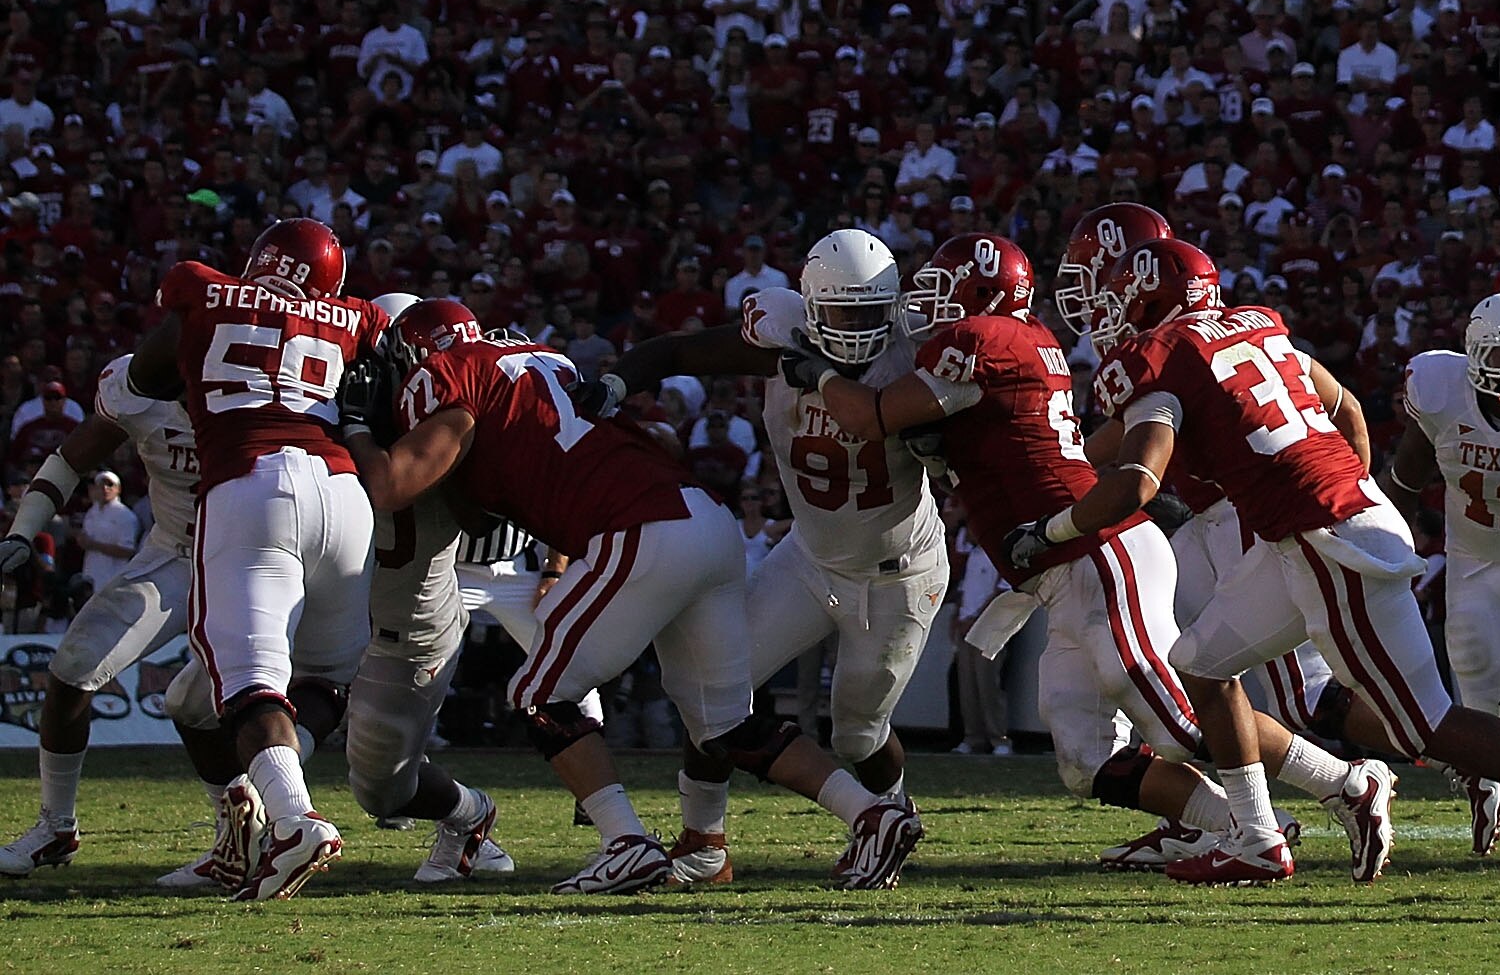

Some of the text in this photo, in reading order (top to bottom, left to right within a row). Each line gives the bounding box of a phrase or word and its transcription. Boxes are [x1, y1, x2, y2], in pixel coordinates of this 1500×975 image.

[974, 238, 1000, 277] OU
[1097, 219, 1127, 257] OU
[275, 255, 311, 286] 59
[1133, 248, 1160, 291] OU
[205, 283, 362, 337] STEPHENSON
[1187, 309, 1276, 344] MILLARD
[933, 345, 977, 383] 61
[398, 366, 441, 430] 77
[1093, 359, 1135, 417] 33
[1210, 334, 1340, 456] 33
[791, 436, 893, 512] 91
